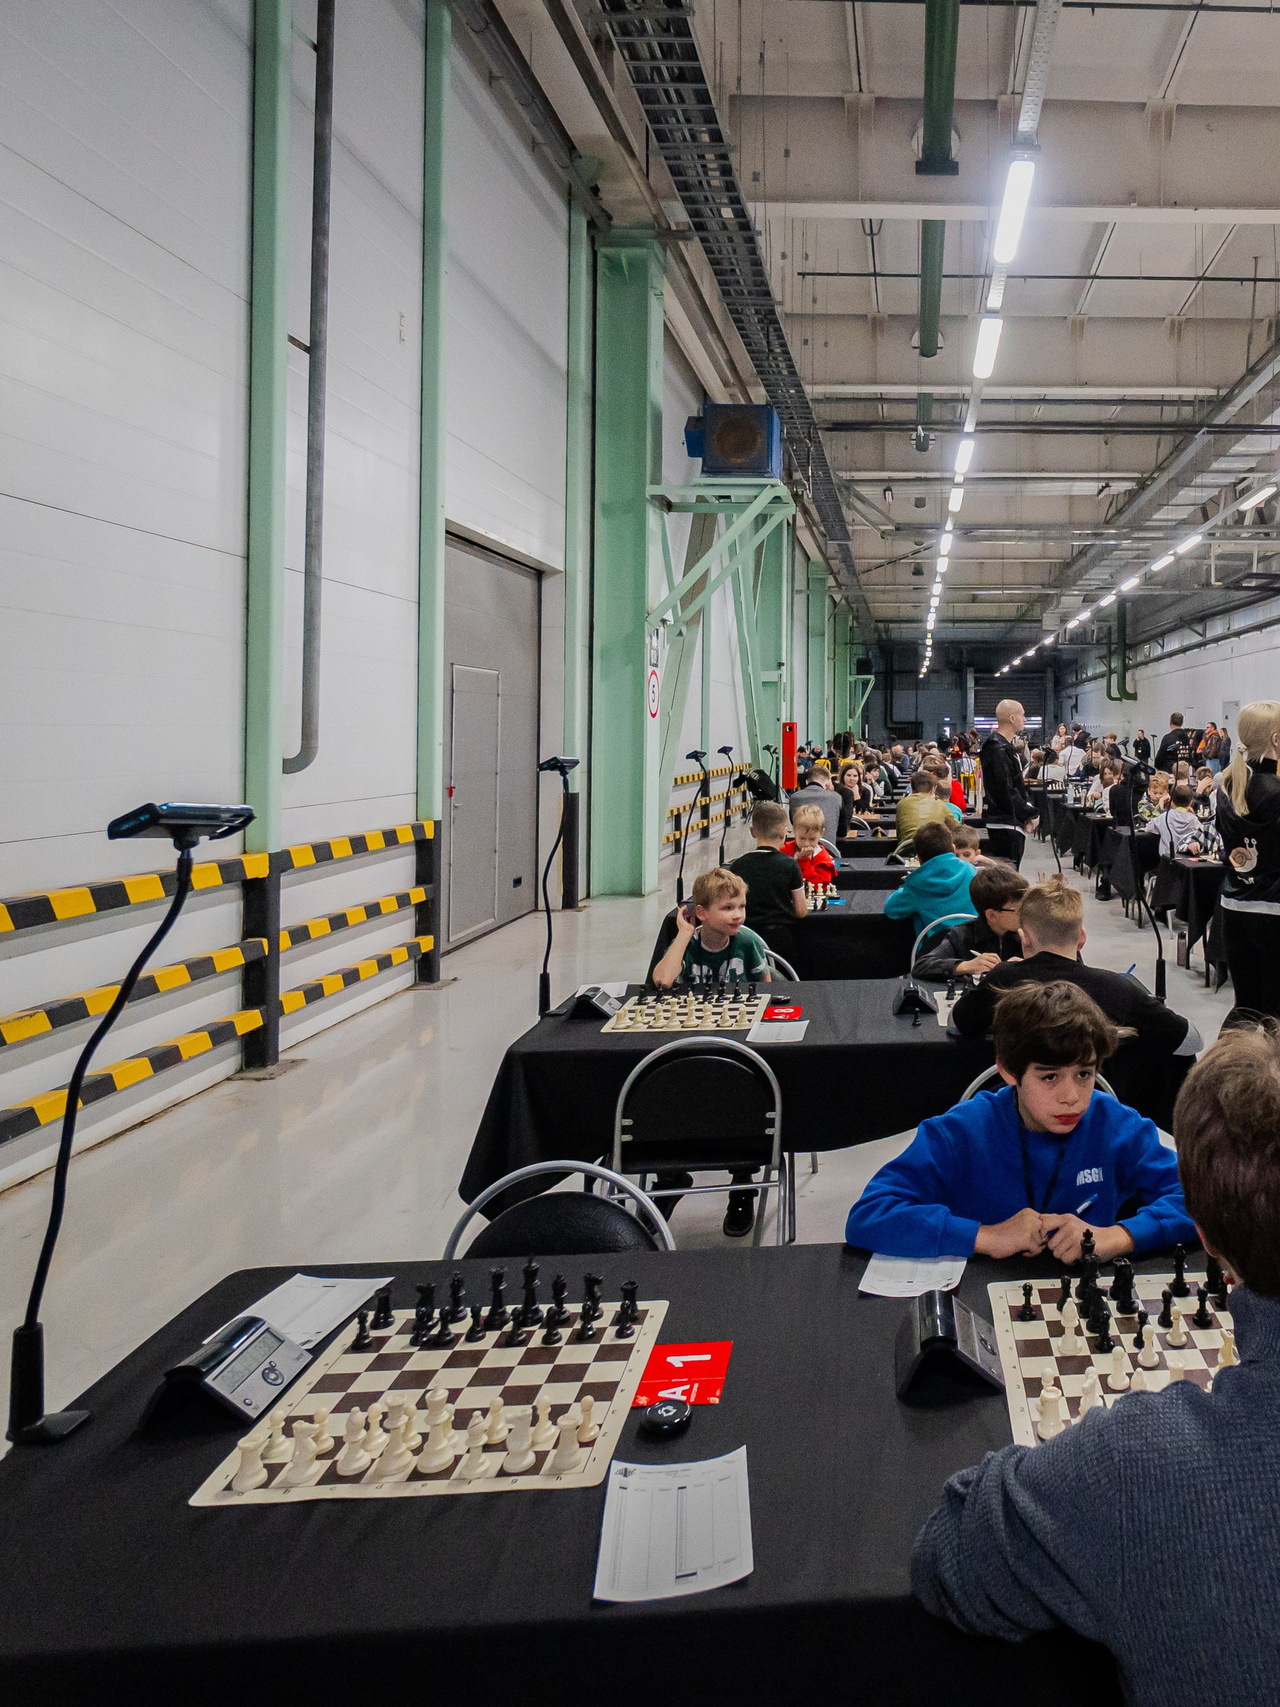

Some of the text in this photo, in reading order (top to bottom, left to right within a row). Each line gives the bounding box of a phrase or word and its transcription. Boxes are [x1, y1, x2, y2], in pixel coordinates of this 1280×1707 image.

[651, 684, 656, 703] 5
[657, 1354, 712, 1401] A 1
